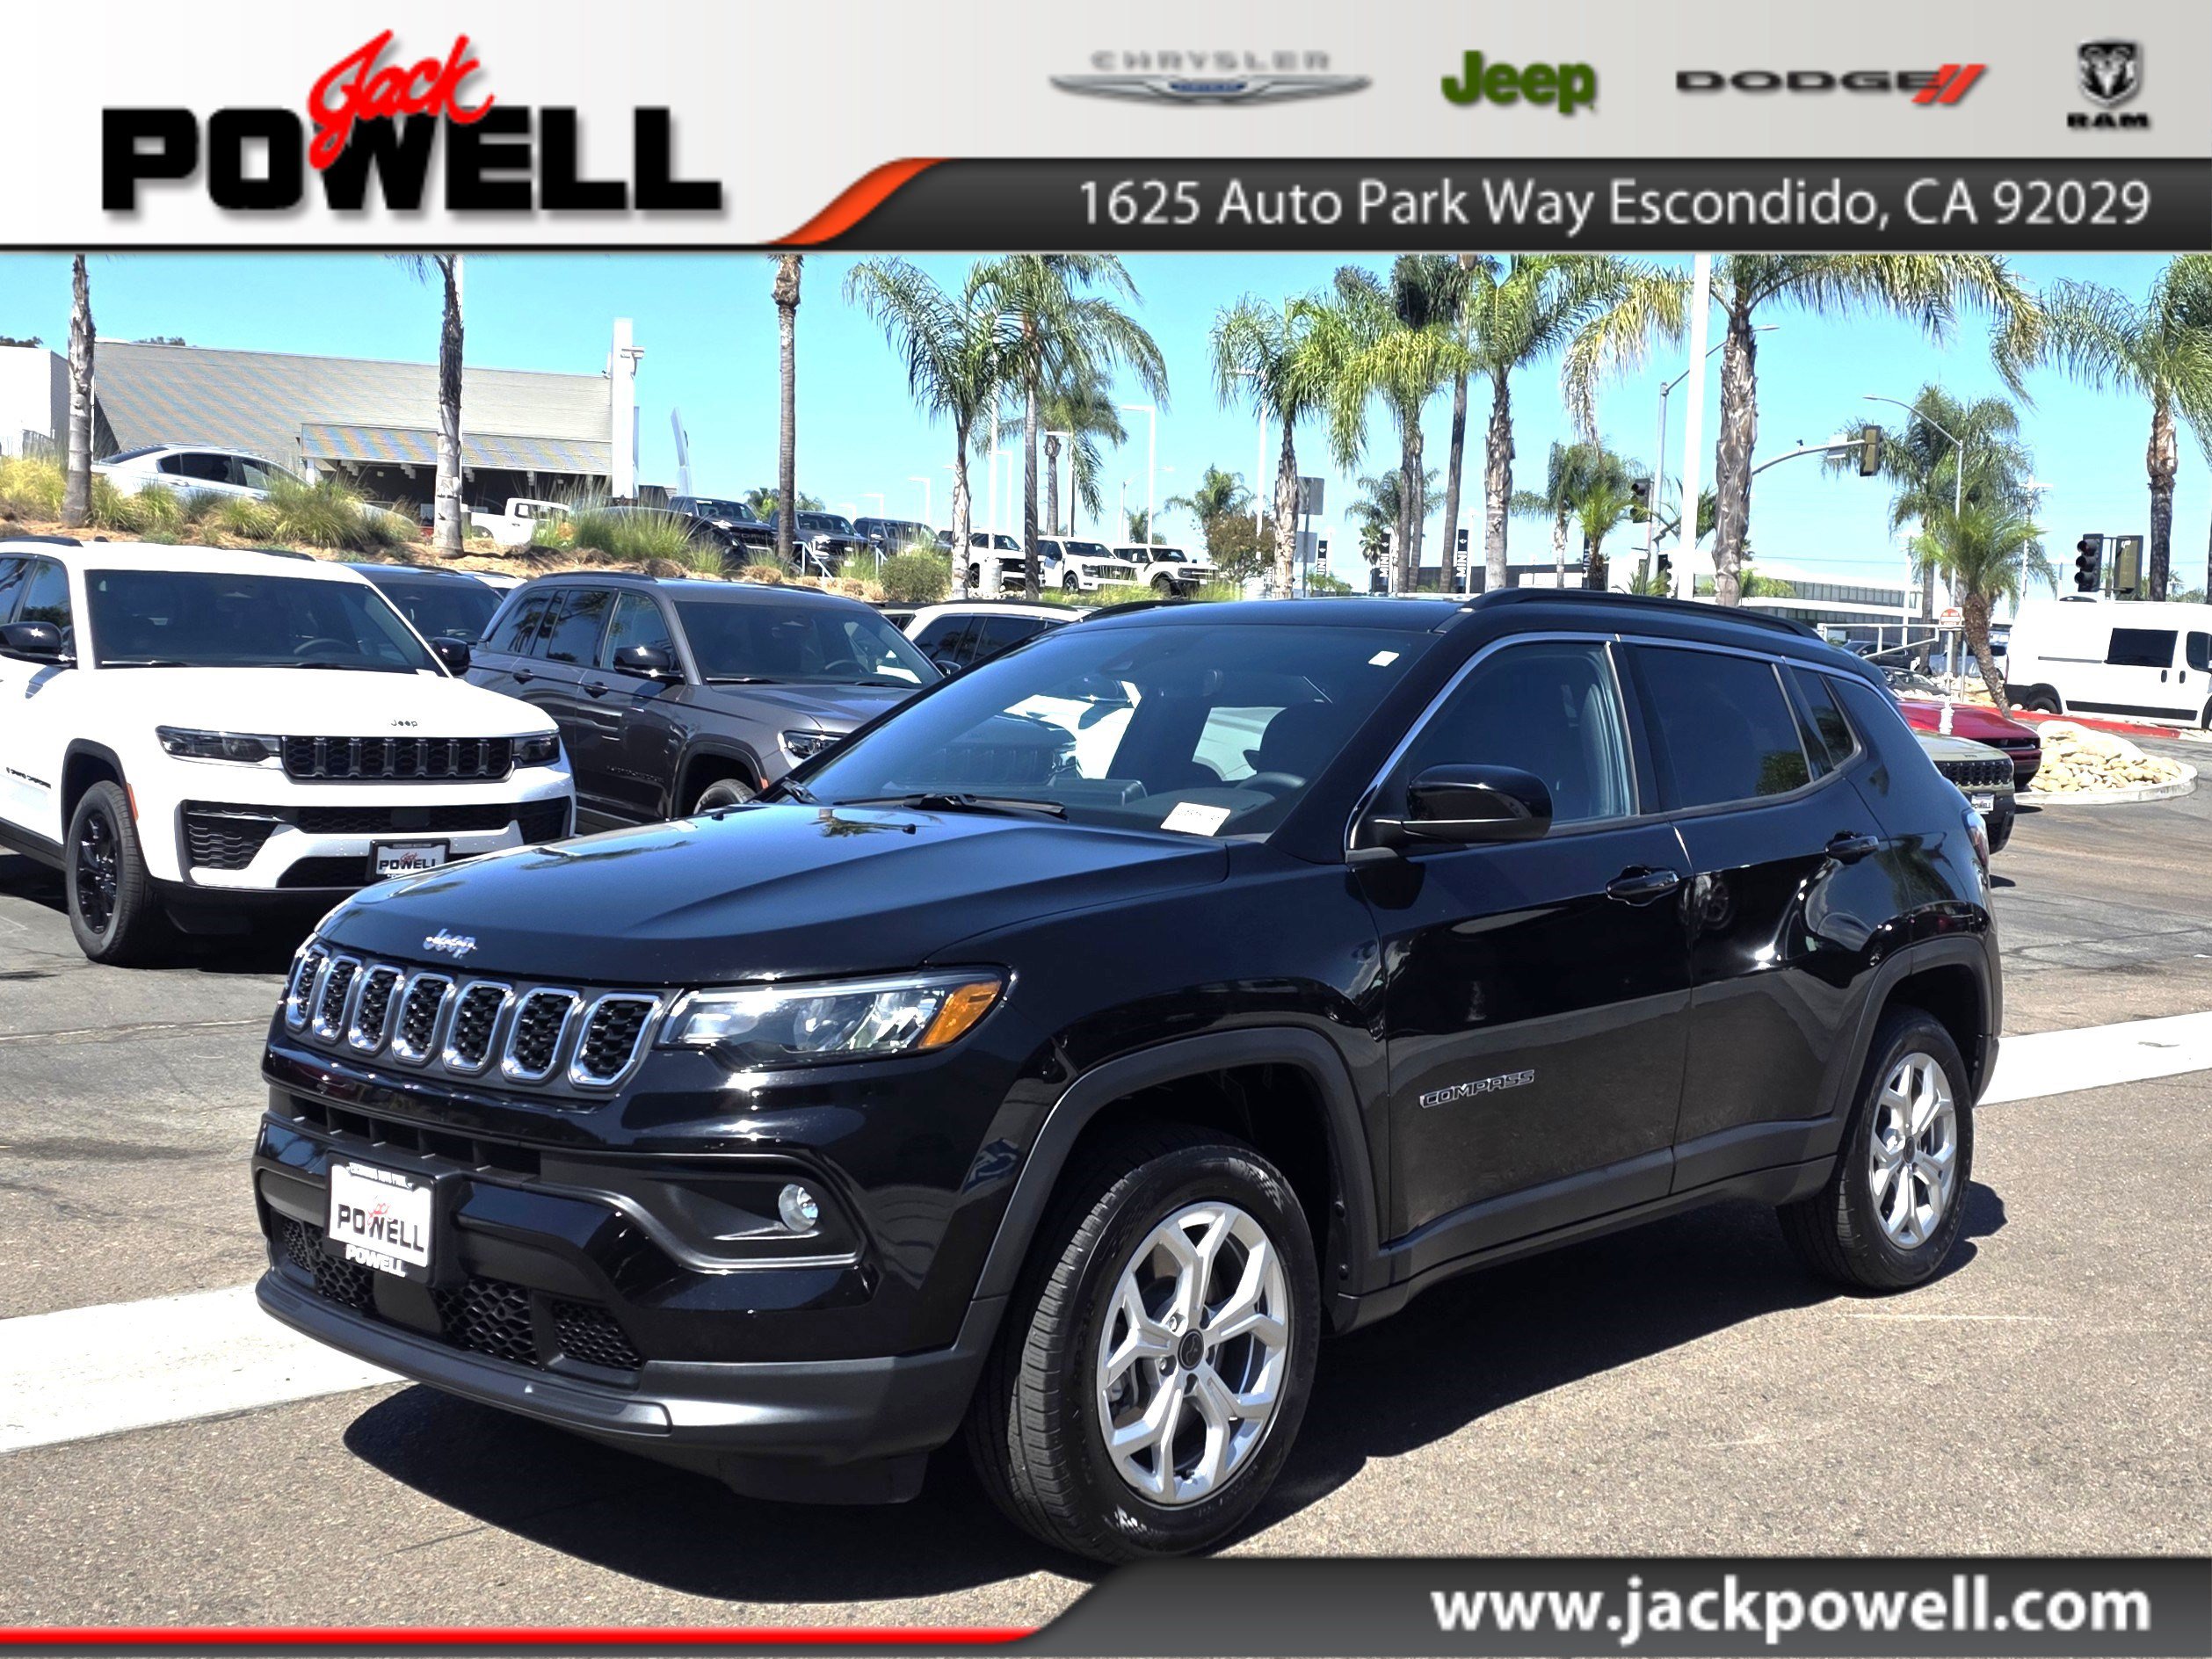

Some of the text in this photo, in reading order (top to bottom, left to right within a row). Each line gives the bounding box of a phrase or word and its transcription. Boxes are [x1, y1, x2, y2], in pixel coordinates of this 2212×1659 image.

[1379, 553, 1389, 577] MINI
[1456, 550, 1468, 577] MINI
[390, 719, 418, 728] Jeep
[423, 928, 477, 960] Jeep
[1419, 1069, 1534, 1108] COMPASS
[337, 1203, 424, 1253] POWELL
[345, 1243, 408, 1278] POWELL
